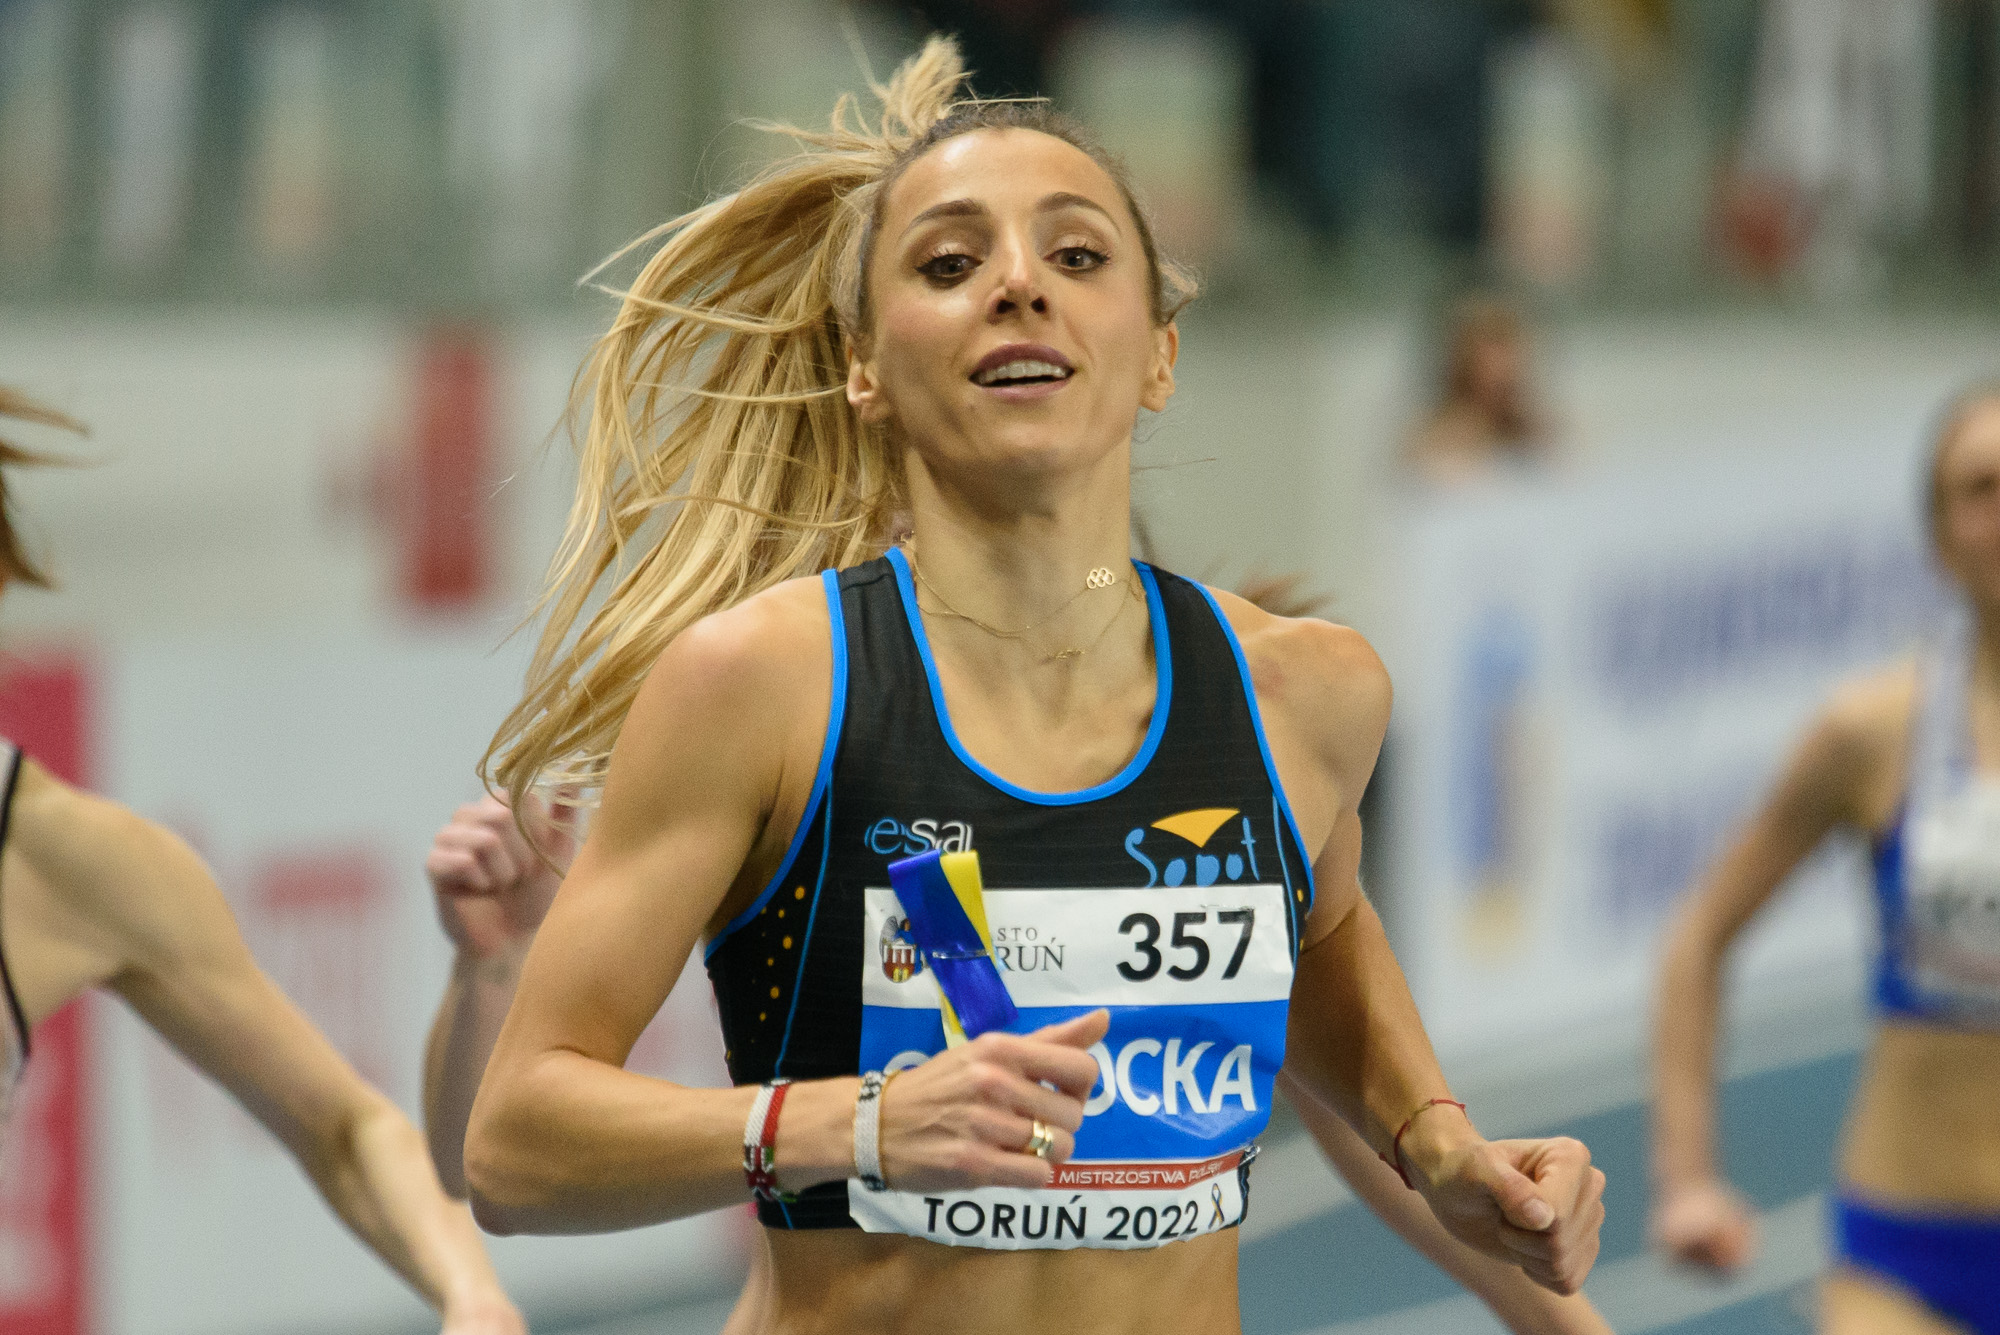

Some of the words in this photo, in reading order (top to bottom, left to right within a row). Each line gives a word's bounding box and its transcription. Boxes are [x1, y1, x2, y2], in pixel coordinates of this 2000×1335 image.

[997, 927, 1038, 942] STO
[1116, 911, 1255, 982] 357
[995, 936, 1066, 972] RUŃ
[1059, 1170, 1186, 1184] MISTRZOSTWA
[924, 1195, 1086, 1241] TORUŃ
[1102, 1200, 1199, 1242] 2022
